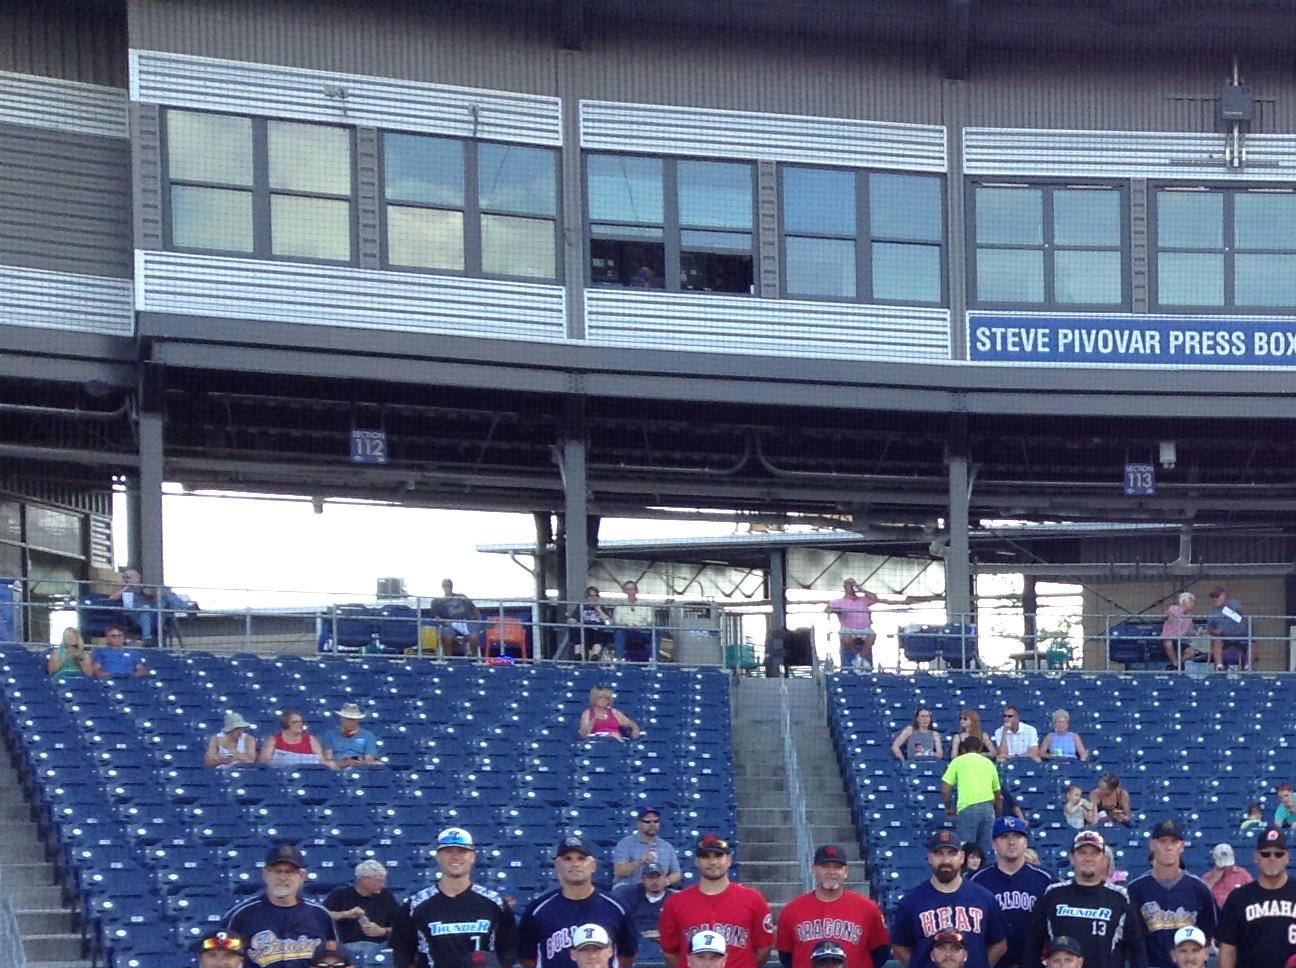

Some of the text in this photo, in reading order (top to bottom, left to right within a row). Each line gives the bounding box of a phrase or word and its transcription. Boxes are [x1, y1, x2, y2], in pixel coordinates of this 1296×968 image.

[975, 326, 1050, 352] STEVE
[1058, 328, 1161, 354] PIVOVAR
[1169, 330, 1246, 356] PRESS
[355, 439, 383, 456] 112
[1128, 472, 1152, 488] 113
[918, 906, 984, 936] HEAT
[1091, 920, 1107, 936] 13
[794, 917, 863, 945] DRAGONS
[470, 935, 482, 951] 7
